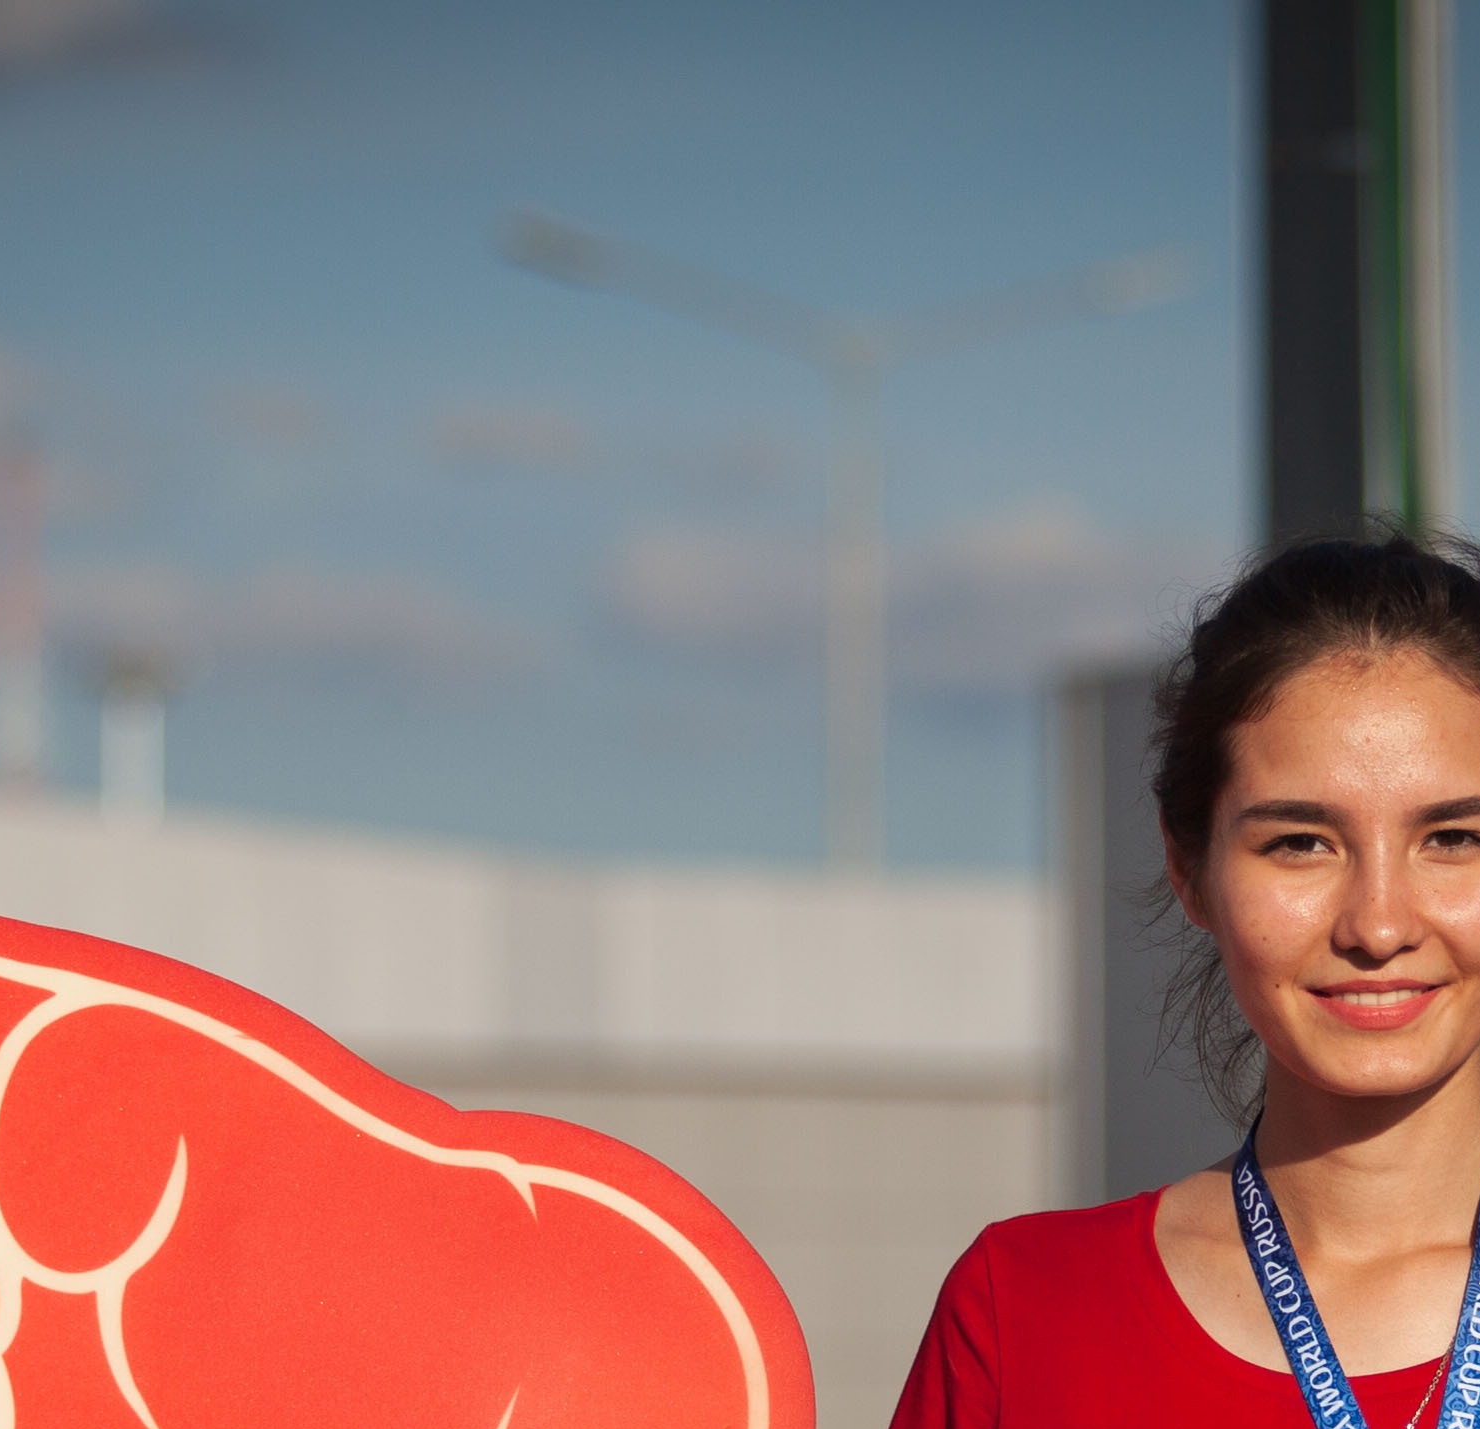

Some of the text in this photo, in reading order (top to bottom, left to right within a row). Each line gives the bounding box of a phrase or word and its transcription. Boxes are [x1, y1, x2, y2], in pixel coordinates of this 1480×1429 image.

[1236, 1161, 1282, 1258] RUSSIA
[1267, 1260, 1302, 1314] CUP
[1288, 1316, 1348, 1421] WORLD
